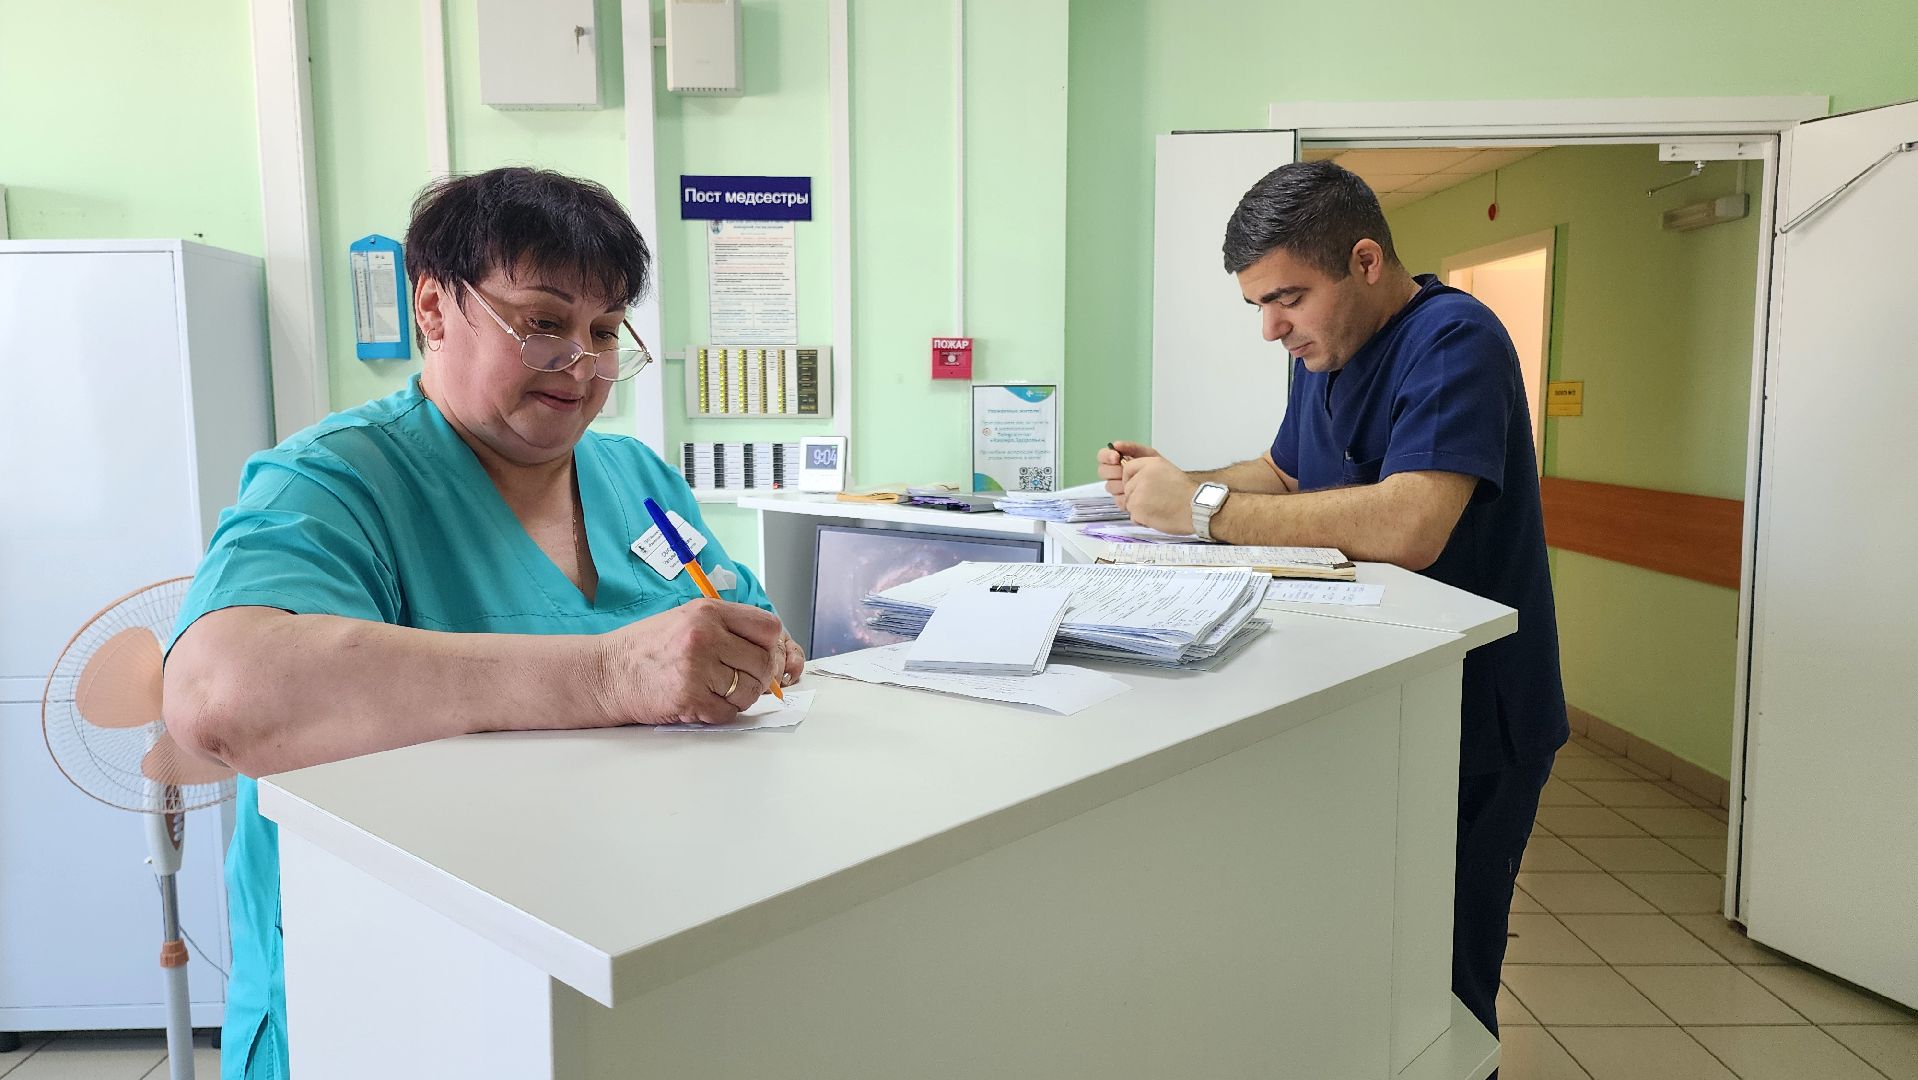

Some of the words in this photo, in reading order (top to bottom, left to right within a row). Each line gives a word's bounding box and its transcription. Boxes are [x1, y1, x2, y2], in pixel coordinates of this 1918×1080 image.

[684, 188, 721, 203] Пост
[725, 191, 808, 207] медсестры
[934, 340, 969, 349] ПОЖАР
[813, 449, 837, 465] 9:04
